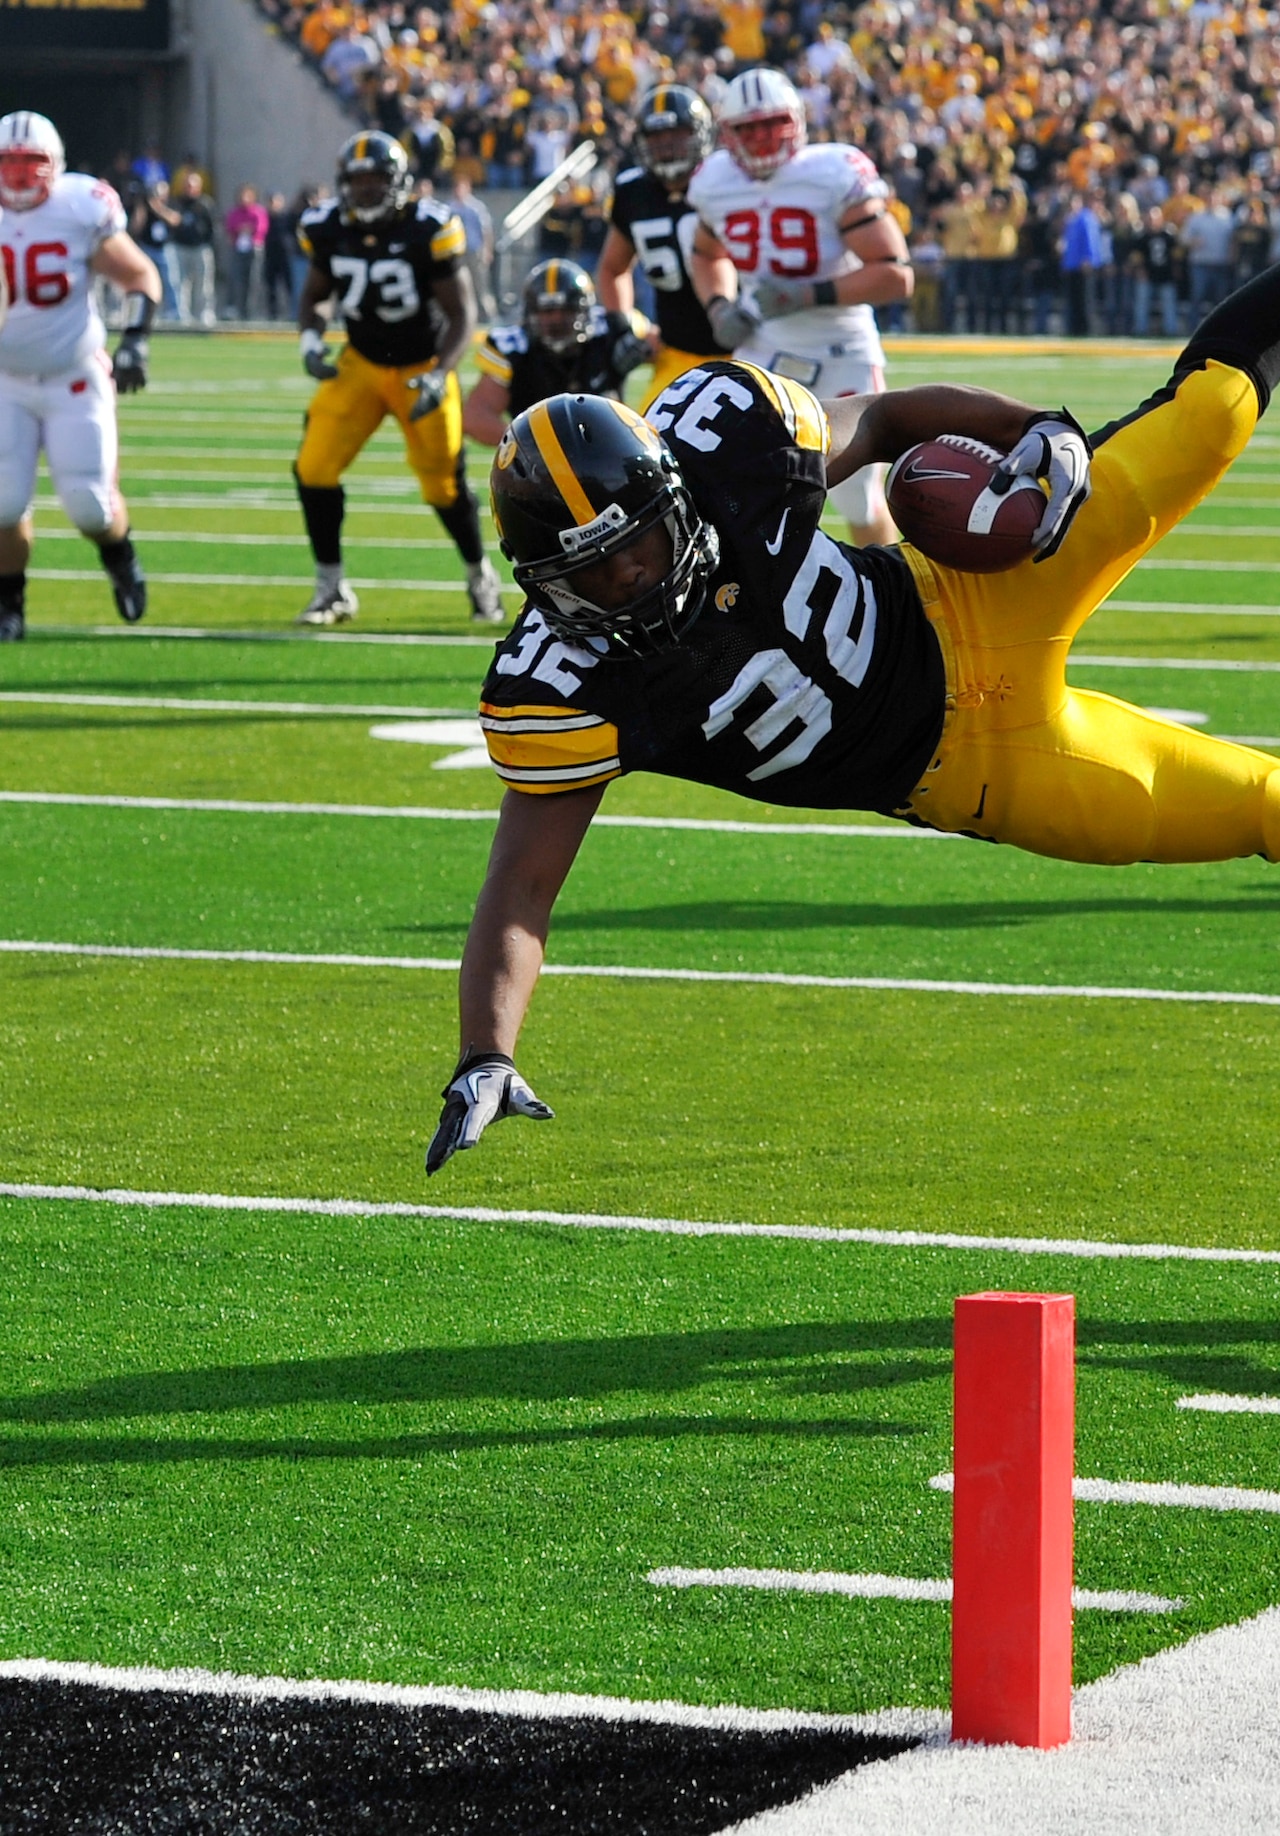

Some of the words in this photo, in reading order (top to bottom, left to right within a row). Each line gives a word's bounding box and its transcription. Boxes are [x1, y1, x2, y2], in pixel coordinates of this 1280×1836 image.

[724, 206, 821, 279] 99
[330, 254, 421, 323] 73
[644, 368, 754, 453] 32
[578, 520, 611, 541] IOWA
[495, 607, 611, 699] 32
[700, 529, 878, 783] 32
